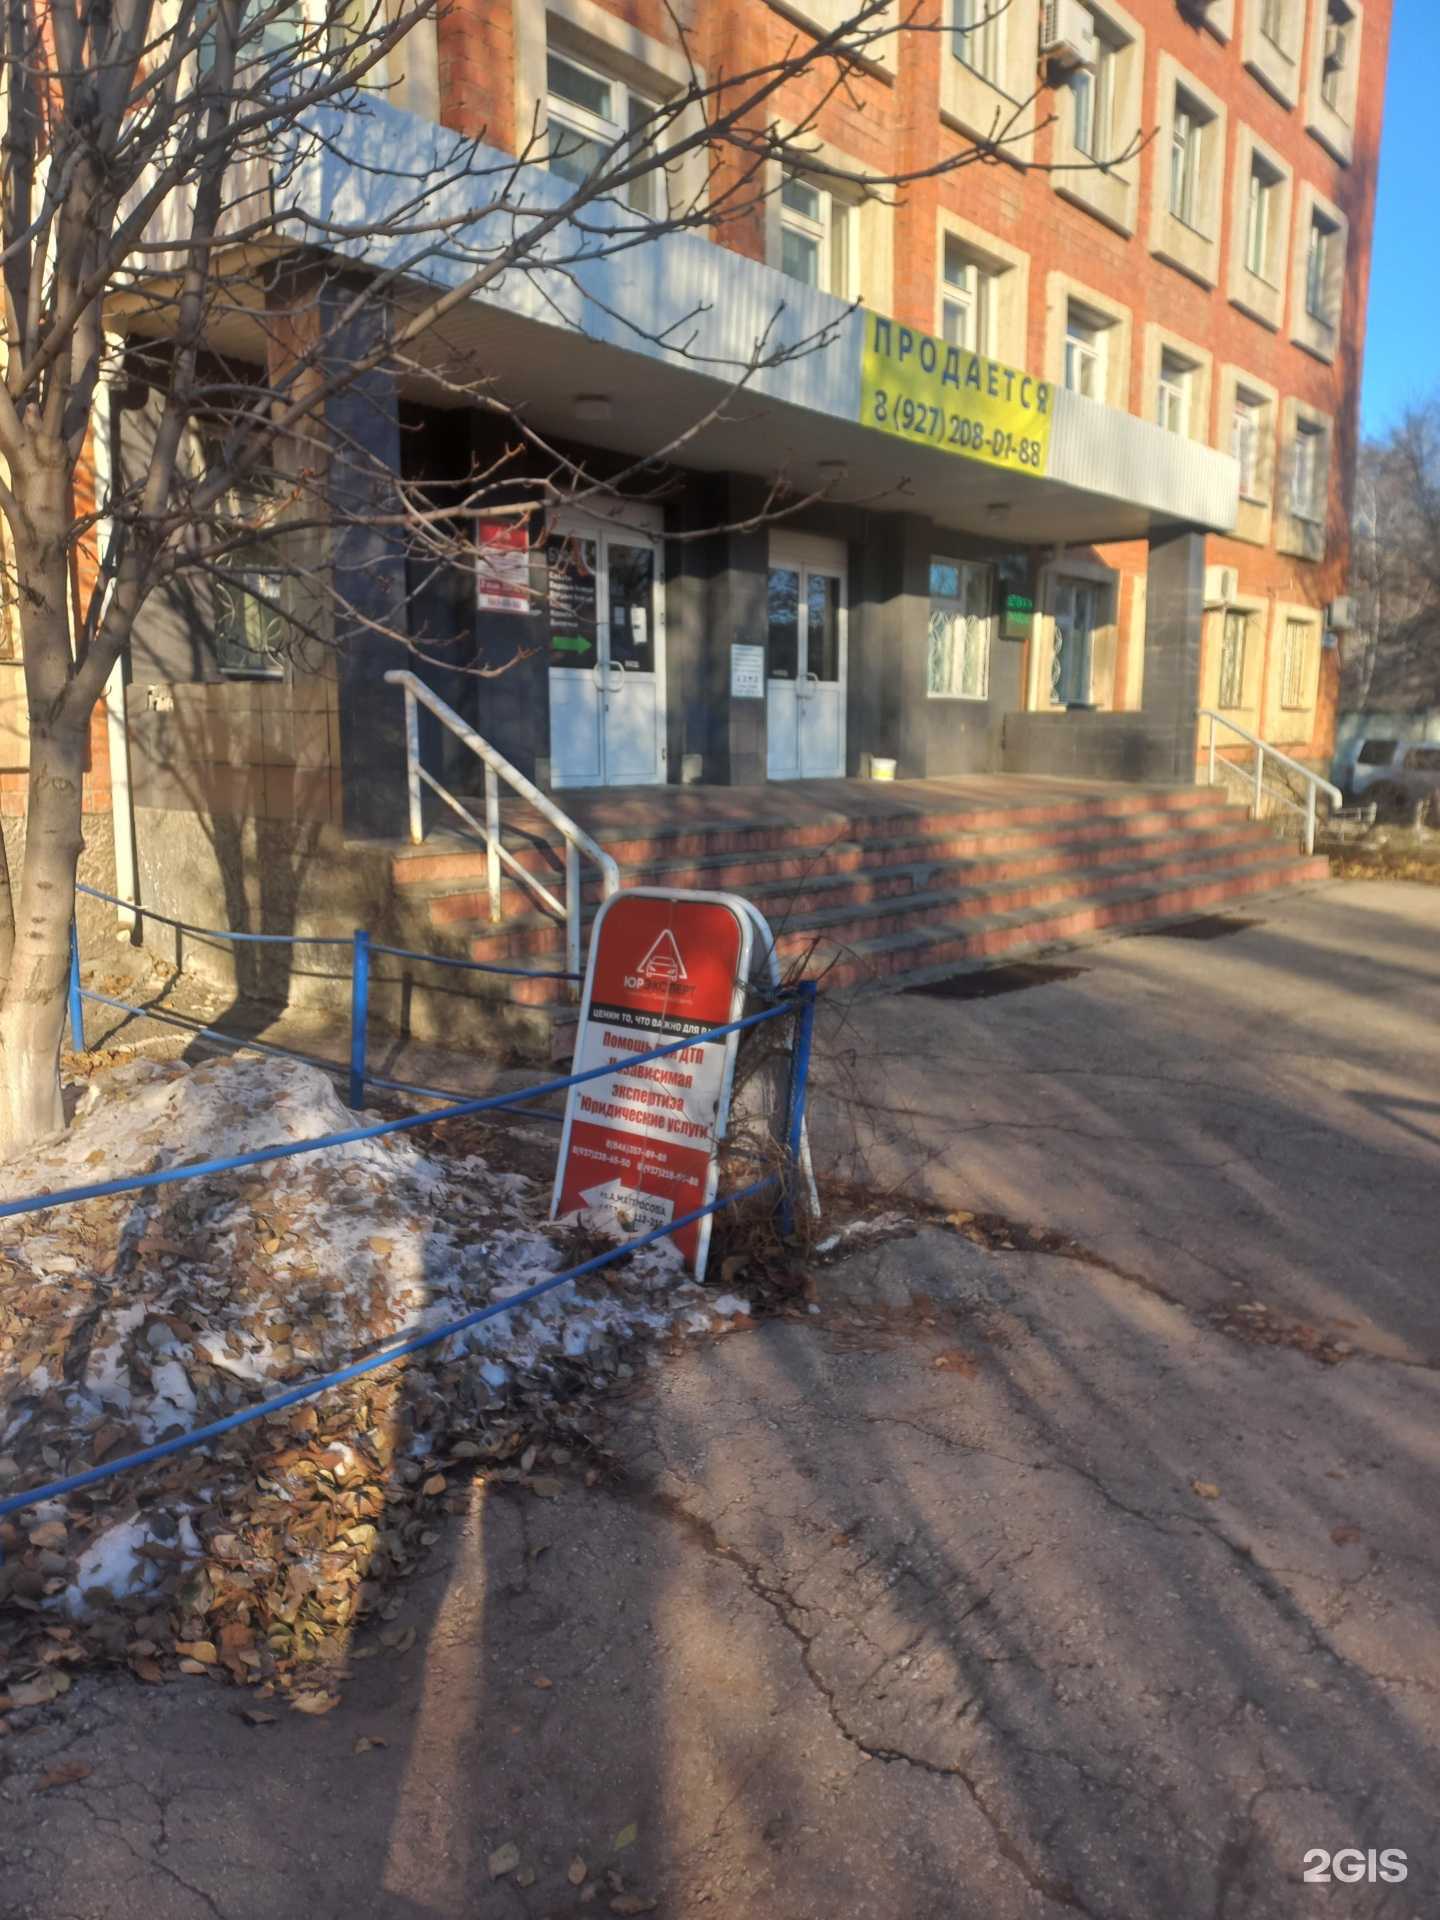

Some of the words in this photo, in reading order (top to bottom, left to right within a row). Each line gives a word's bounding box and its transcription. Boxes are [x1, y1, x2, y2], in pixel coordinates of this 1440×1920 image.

[874, 316, 1049, 414] ПРОДАЕТСЯ
[635, 1016, 651, 1026] ЧТО
[682, 1023, 700, 1034] ДЛЯ
[679, 1047, 705, 1064] ДТП
